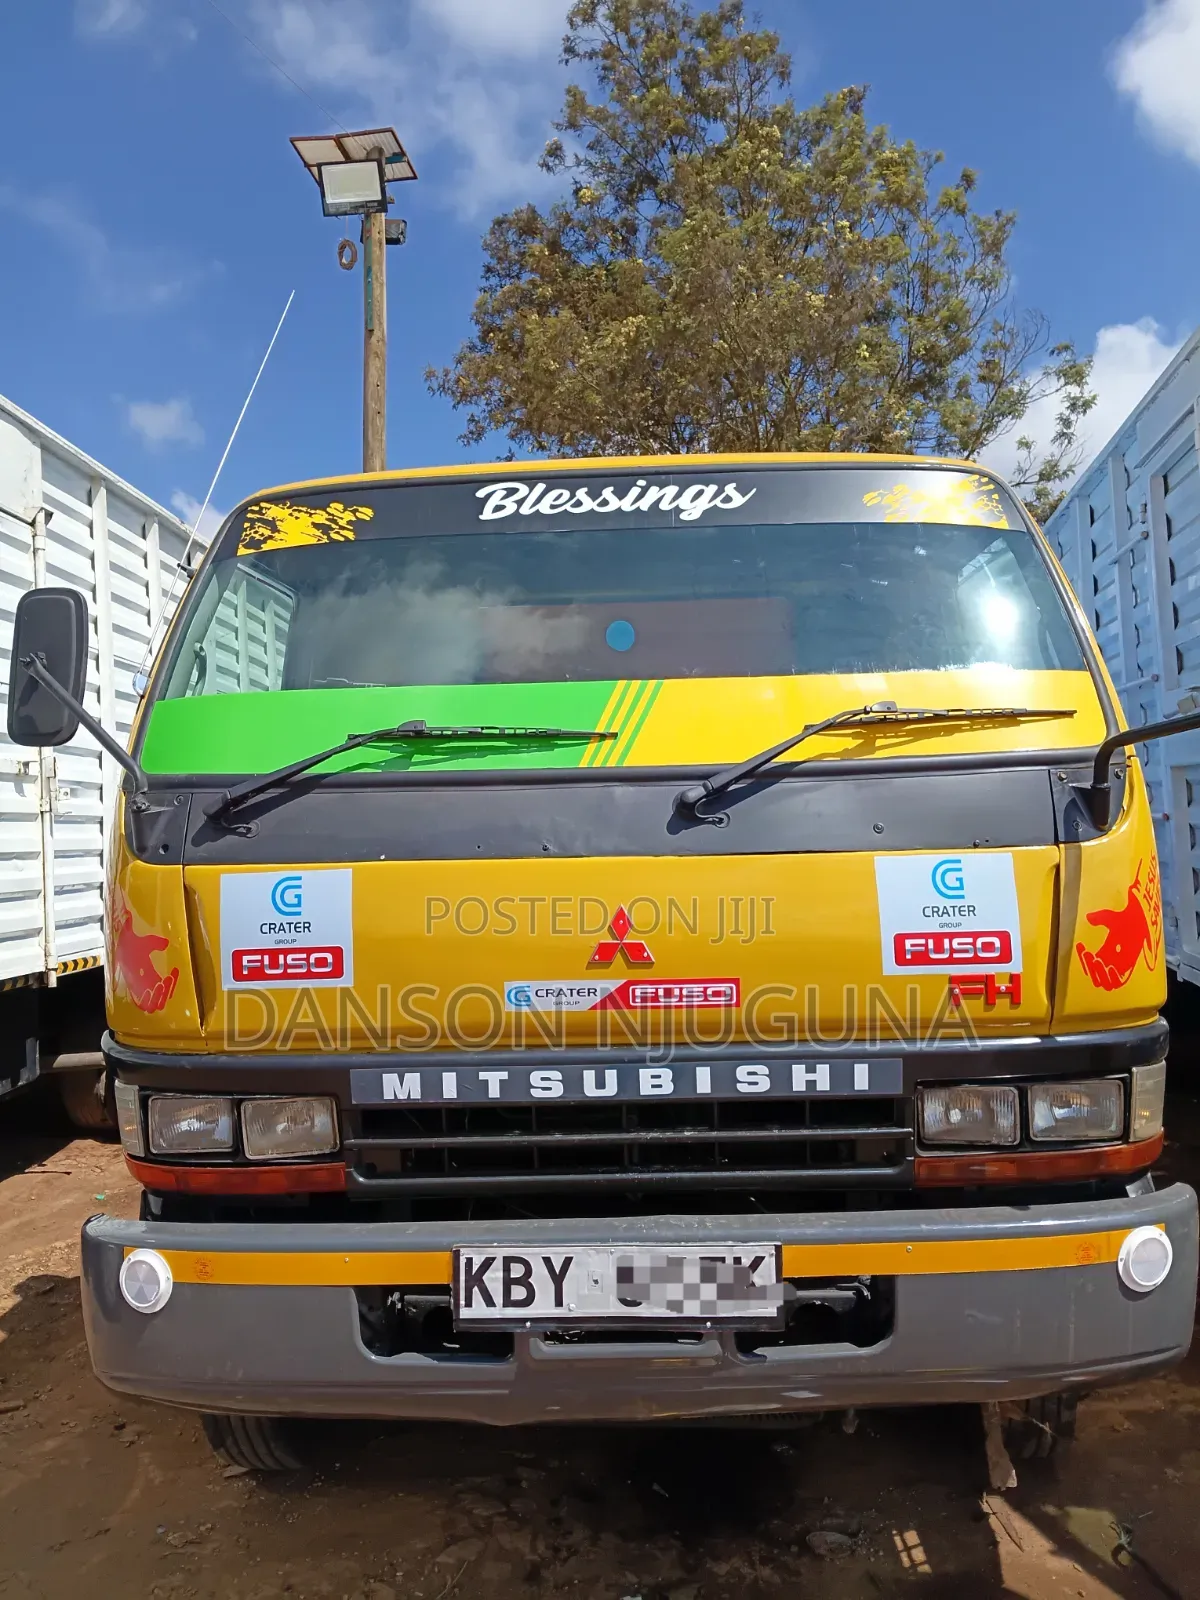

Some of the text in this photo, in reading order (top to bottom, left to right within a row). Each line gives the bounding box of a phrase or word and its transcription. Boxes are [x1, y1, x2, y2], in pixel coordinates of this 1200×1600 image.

[475, 479, 757, 521] Blessings
[922, 904, 977, 918] CRATER
[259, 921, 312, 935] CRATER
[938, 921, 963, 929] GROUP
[904, 936, 1001, 960] FUSO
[242, 952, 333, 975] FUSO
[534, 987, 598, 999] CRATER
[634, 986, 732, 1004] FUSO
[949, 972, 1022, 1006] FH
[381, 1063, 870, 1100] MITSUBISHI
[464, 1255, 575, 1309] KBY
